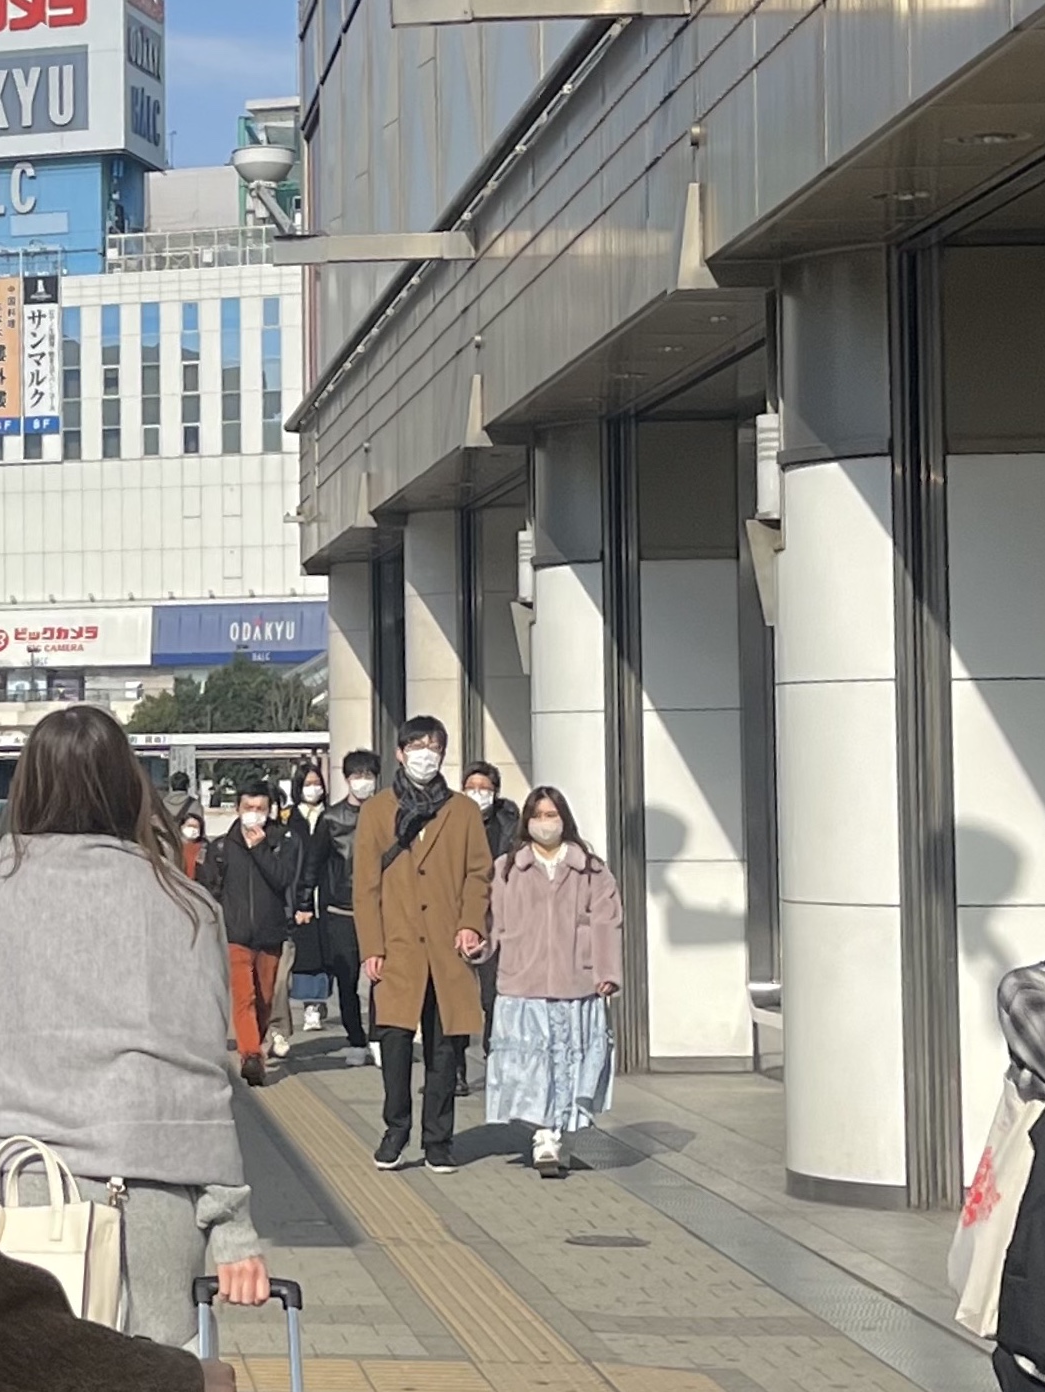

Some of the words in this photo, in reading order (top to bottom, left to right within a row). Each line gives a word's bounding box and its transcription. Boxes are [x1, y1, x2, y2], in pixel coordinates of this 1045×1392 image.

[27, 309, 48, 408] サンマルク
[14, 626, 98, 640] ビックカメラ
[229, 620, 295, 641] ODAKYU
[44, 643, 84, 652] CAMERA
